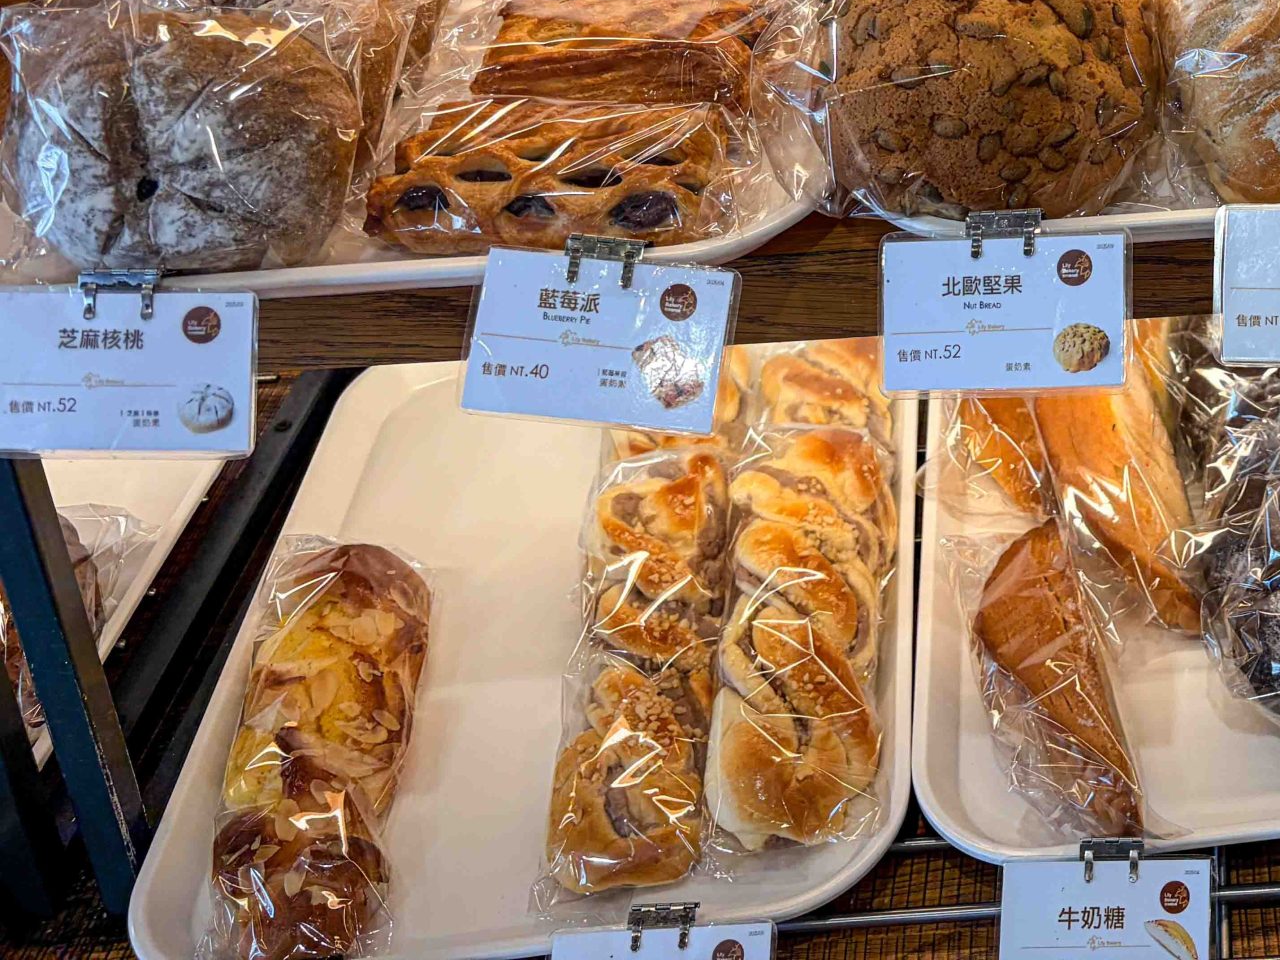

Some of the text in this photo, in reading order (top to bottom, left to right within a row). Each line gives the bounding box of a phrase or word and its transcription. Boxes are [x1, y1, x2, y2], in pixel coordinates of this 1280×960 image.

[941, 274, 1022, 297] 北歐堅果
[537, 287, 600, 314] 藍莓派
[963, 301, 1001, 310] NUT BREAD
[1236, 314, 1261, 328] 售價
[58, 328, 144, 350] 芝麻核桃
[896, 344, 961, 362] 售價 NT.52
[481, 361, 549, 379] 售價 NT.40
[9, 398, 77, 414] 售價 NT.52
[1057, 905, 1125, 930] 牛奶糖
